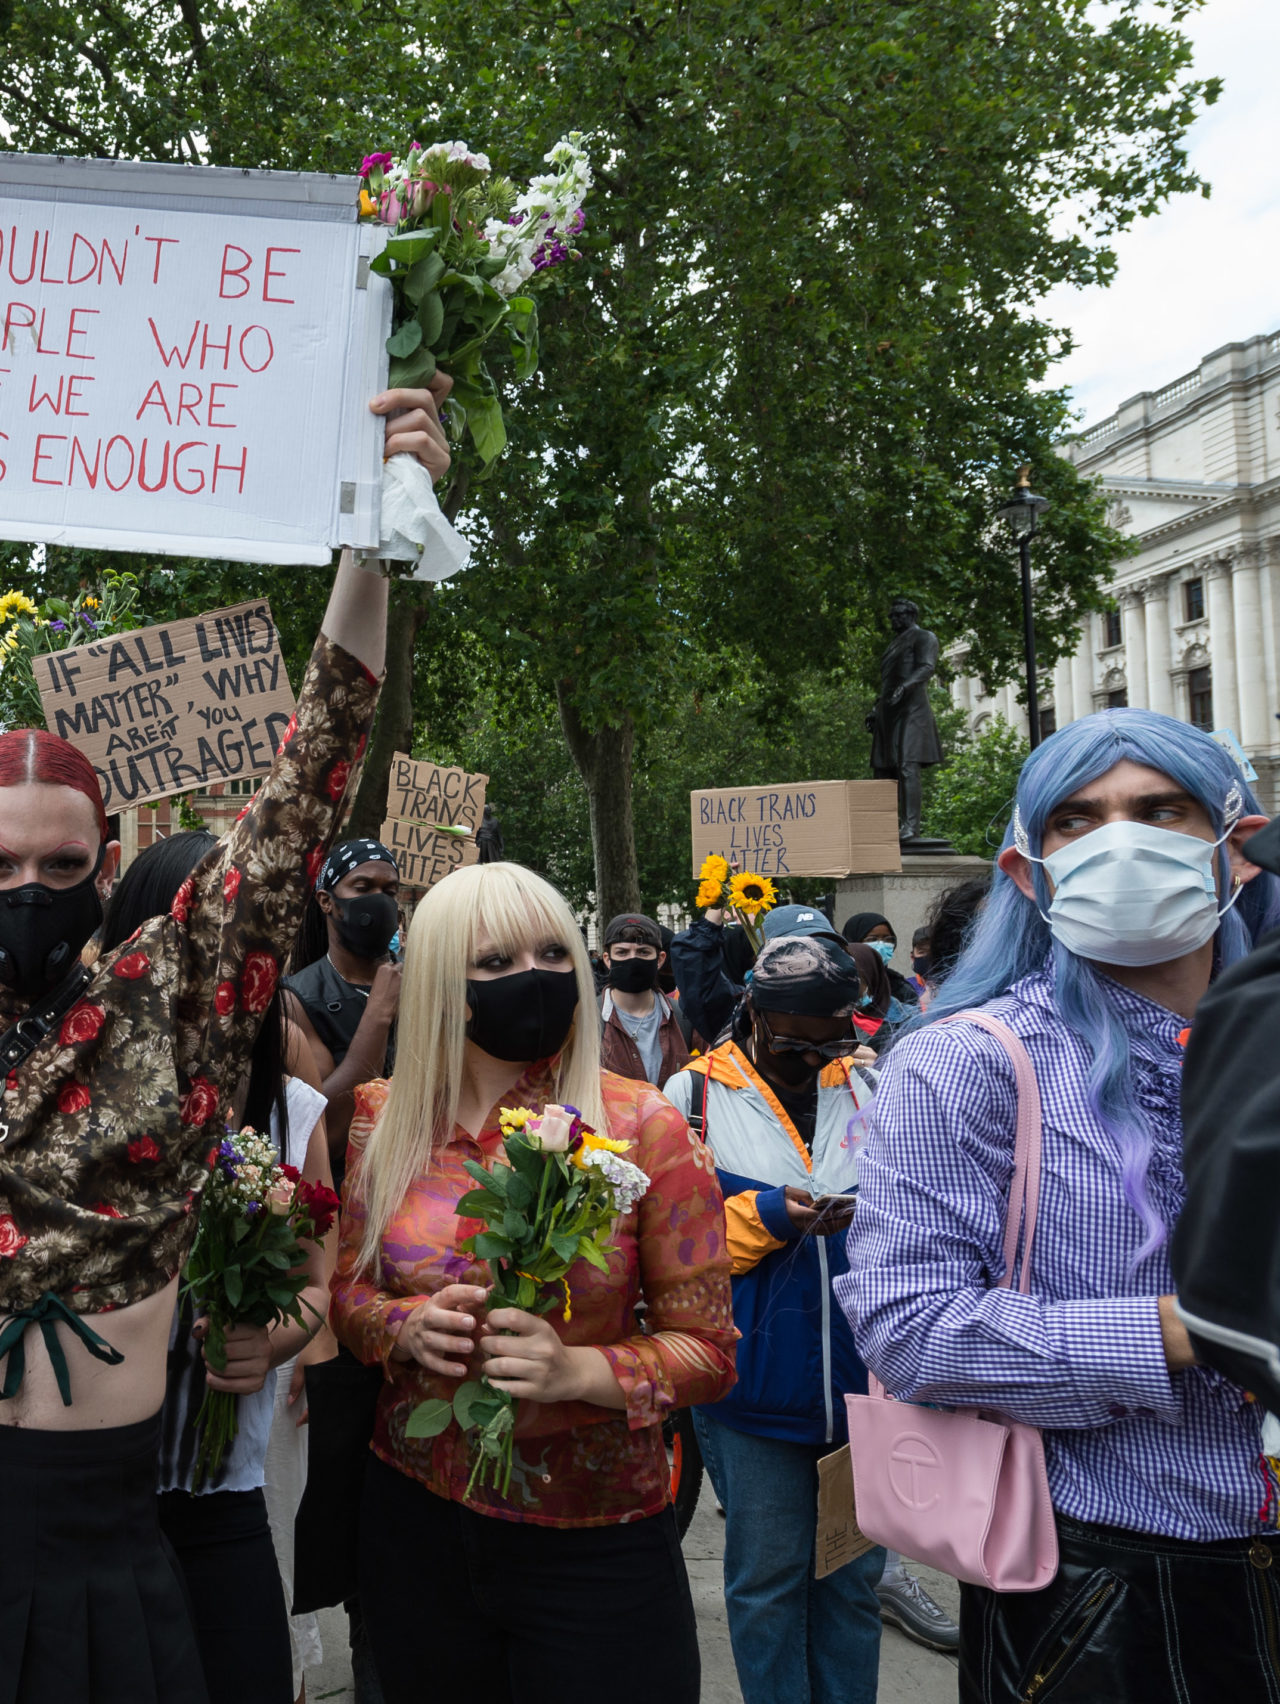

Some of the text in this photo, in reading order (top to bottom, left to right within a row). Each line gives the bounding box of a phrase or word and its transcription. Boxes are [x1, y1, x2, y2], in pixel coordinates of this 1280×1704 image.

[219, 244, 301, 305] BE
[148, 318, 275, 373] WHO
[28, 375, 95, 417] WE
[136, 380, 239, 428] ARE
[32, 434, 248, 495] ENOUGH
[46, 651, 82, 697] IF
[195, 606, 275, 663] LIVES
[202, 654, 280, 701] WHY
[396, 760, 482, 809] BLACK
[396, 787, 477, 831] TRANS
[700, 793, 817, 825] BLACK TRANS
[391, 821, 465, 864] LIVES
[708, 847, 791, 874] ATTER
[730, 824, 784, 849] LIVES
[391, 847, 456, 885] ATTE
[823, 1520, 849, 1571] THE
